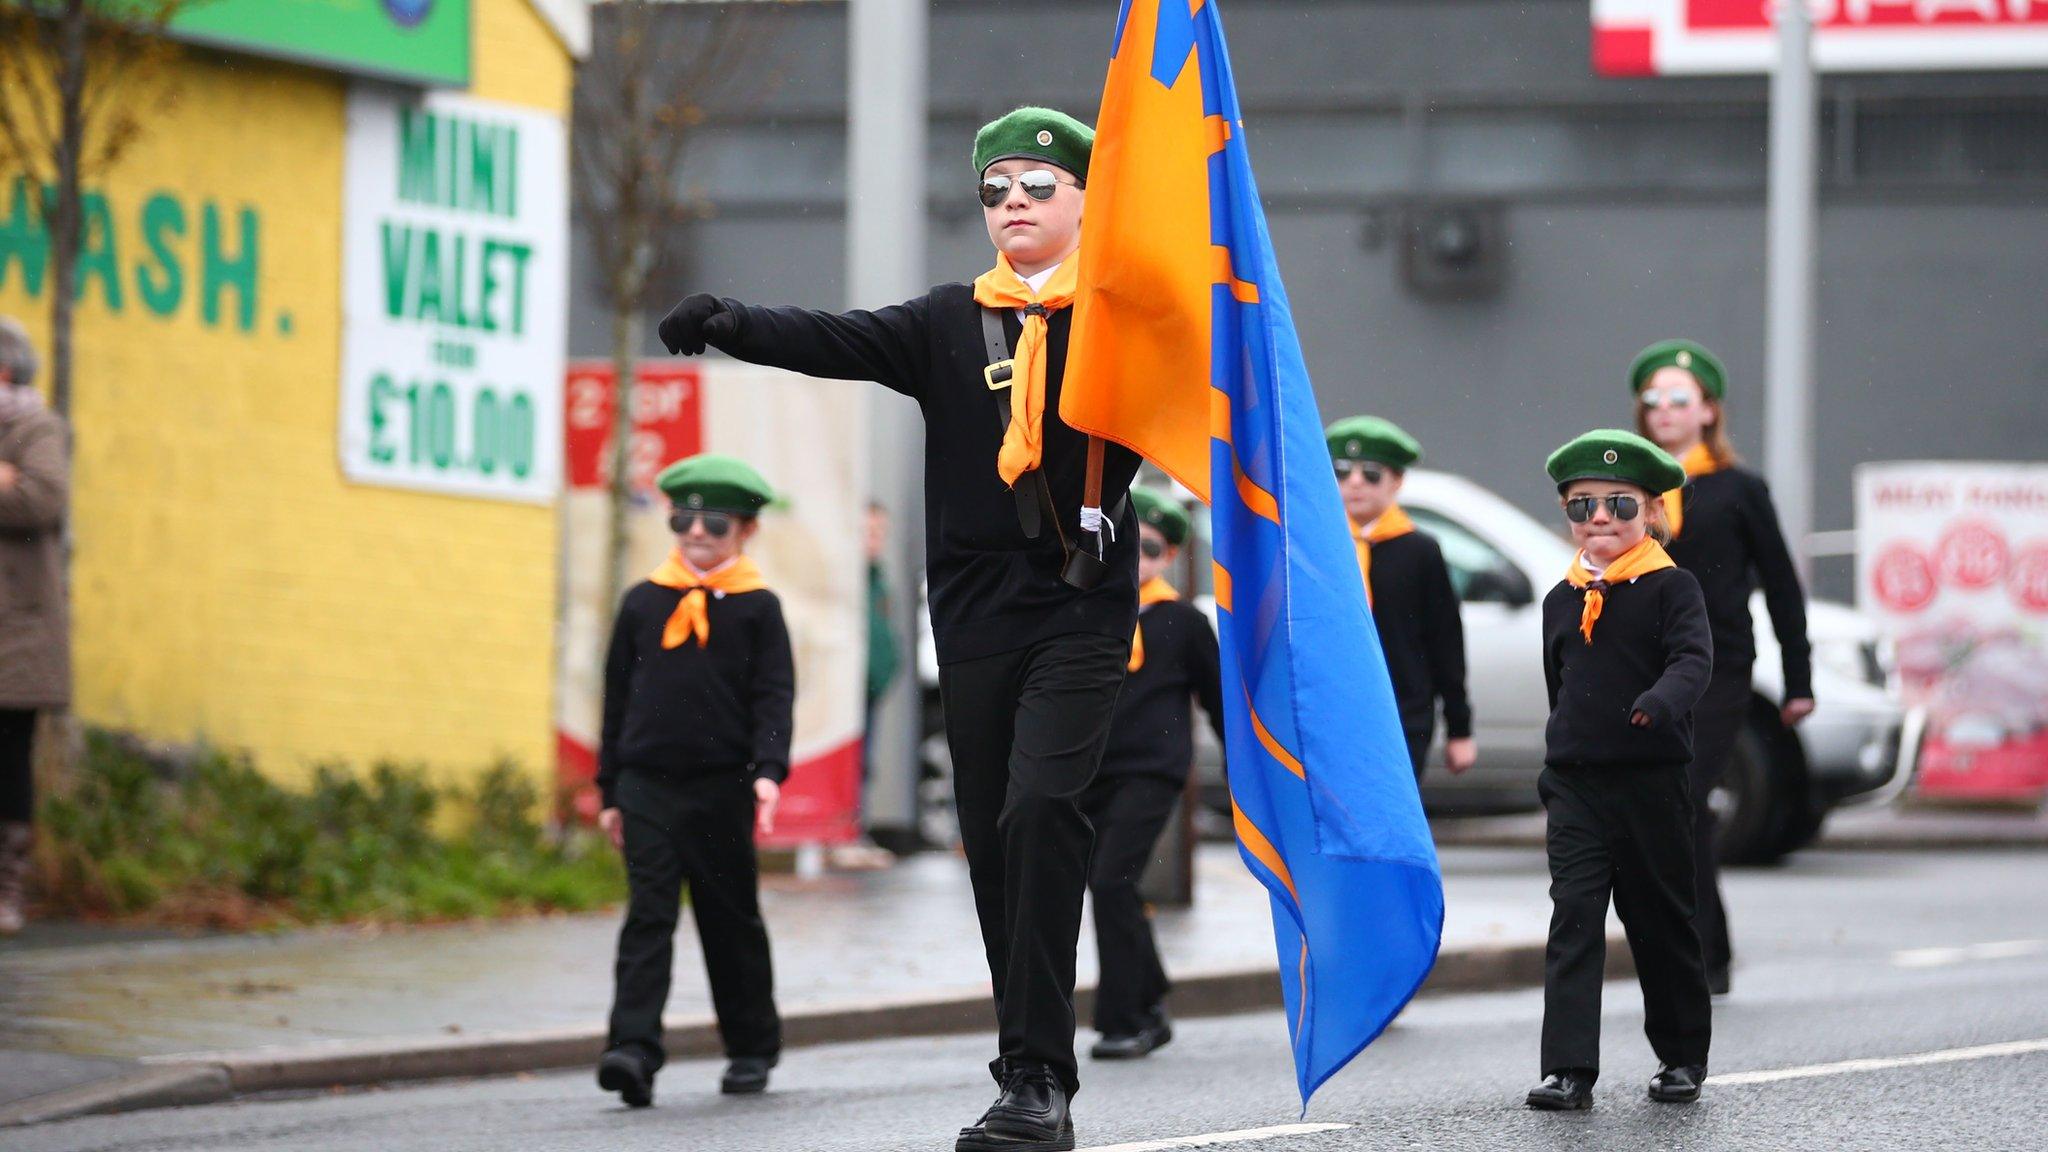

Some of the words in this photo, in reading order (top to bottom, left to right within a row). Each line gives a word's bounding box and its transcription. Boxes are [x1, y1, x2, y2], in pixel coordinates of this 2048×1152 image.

[397, 104, 518, 219] MINI
[380, 218, 533, 336] VALET
[368, 371, 534, 478] £10.00
[570, 378, 607, 429] 2
